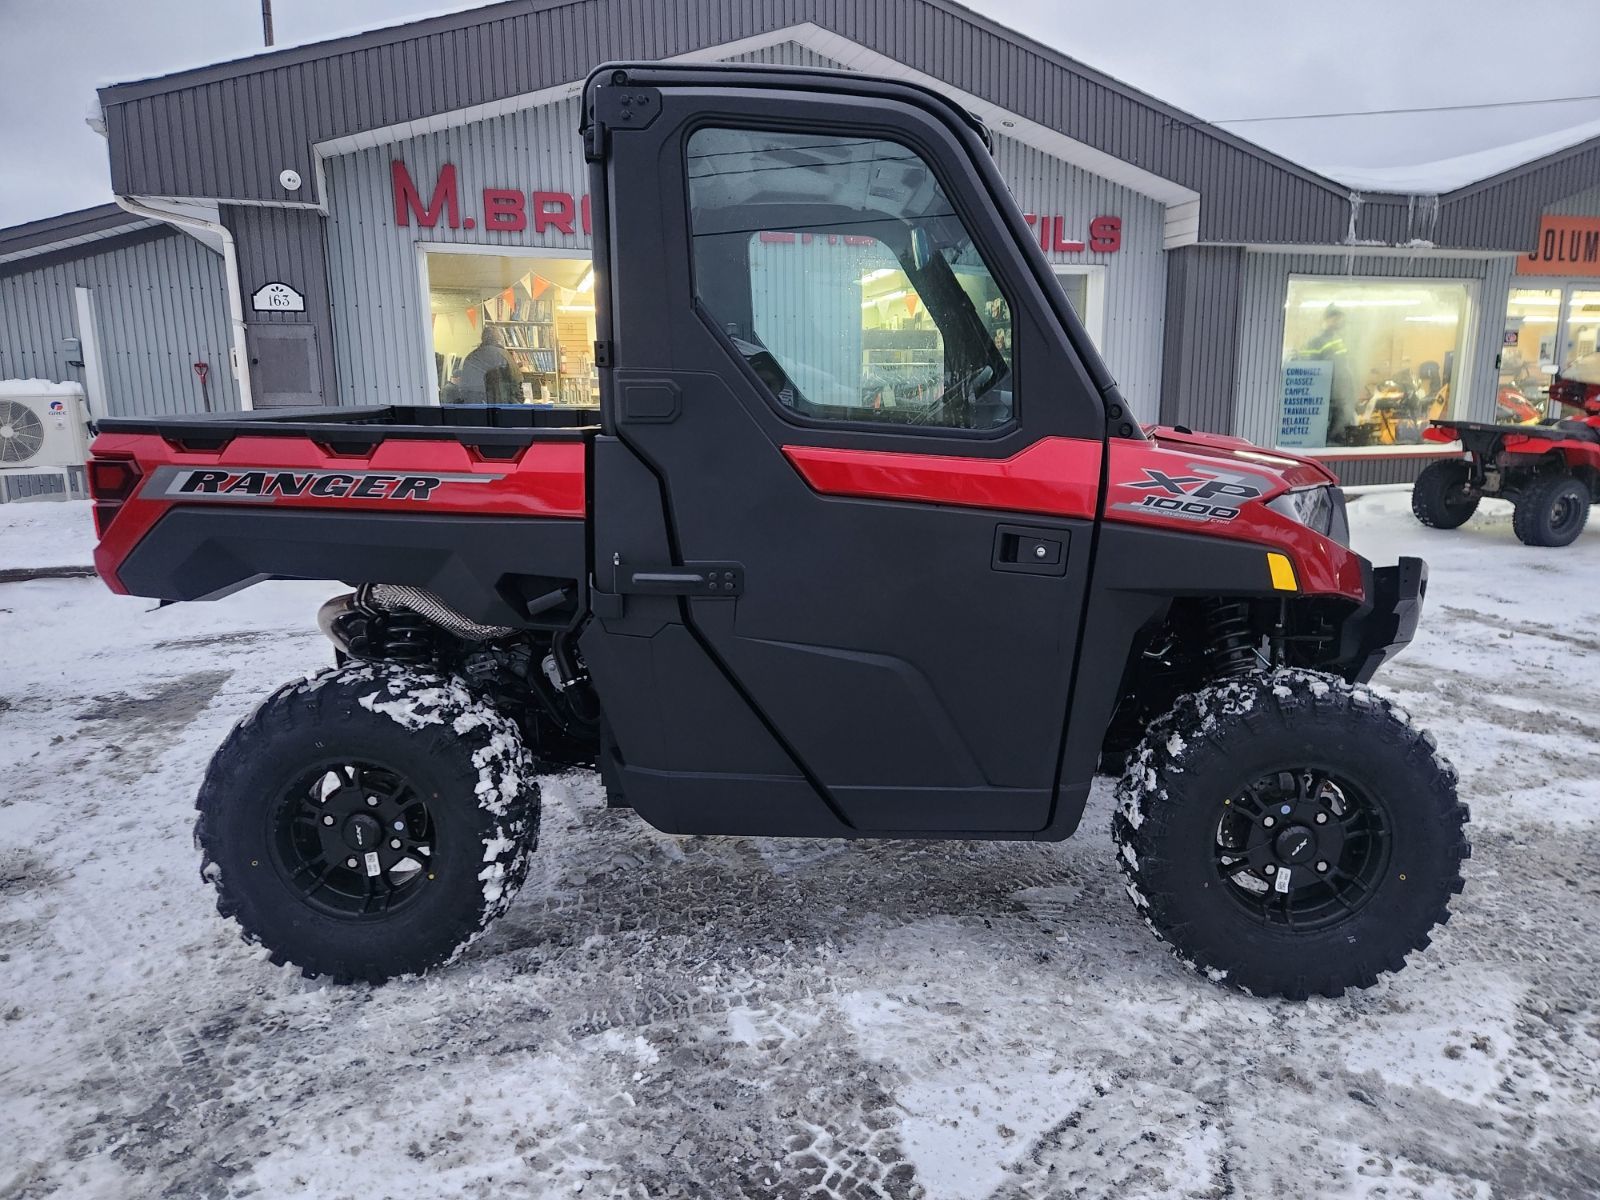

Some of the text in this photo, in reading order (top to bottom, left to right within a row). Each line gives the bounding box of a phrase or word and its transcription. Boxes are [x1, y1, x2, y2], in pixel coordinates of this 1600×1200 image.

[269, 294, 290, 307] 163
[179, 469, 443, 500] RANGER
[1114, 467, 1263, 499] XP
[1141, 495, 1241, 520] 1000
